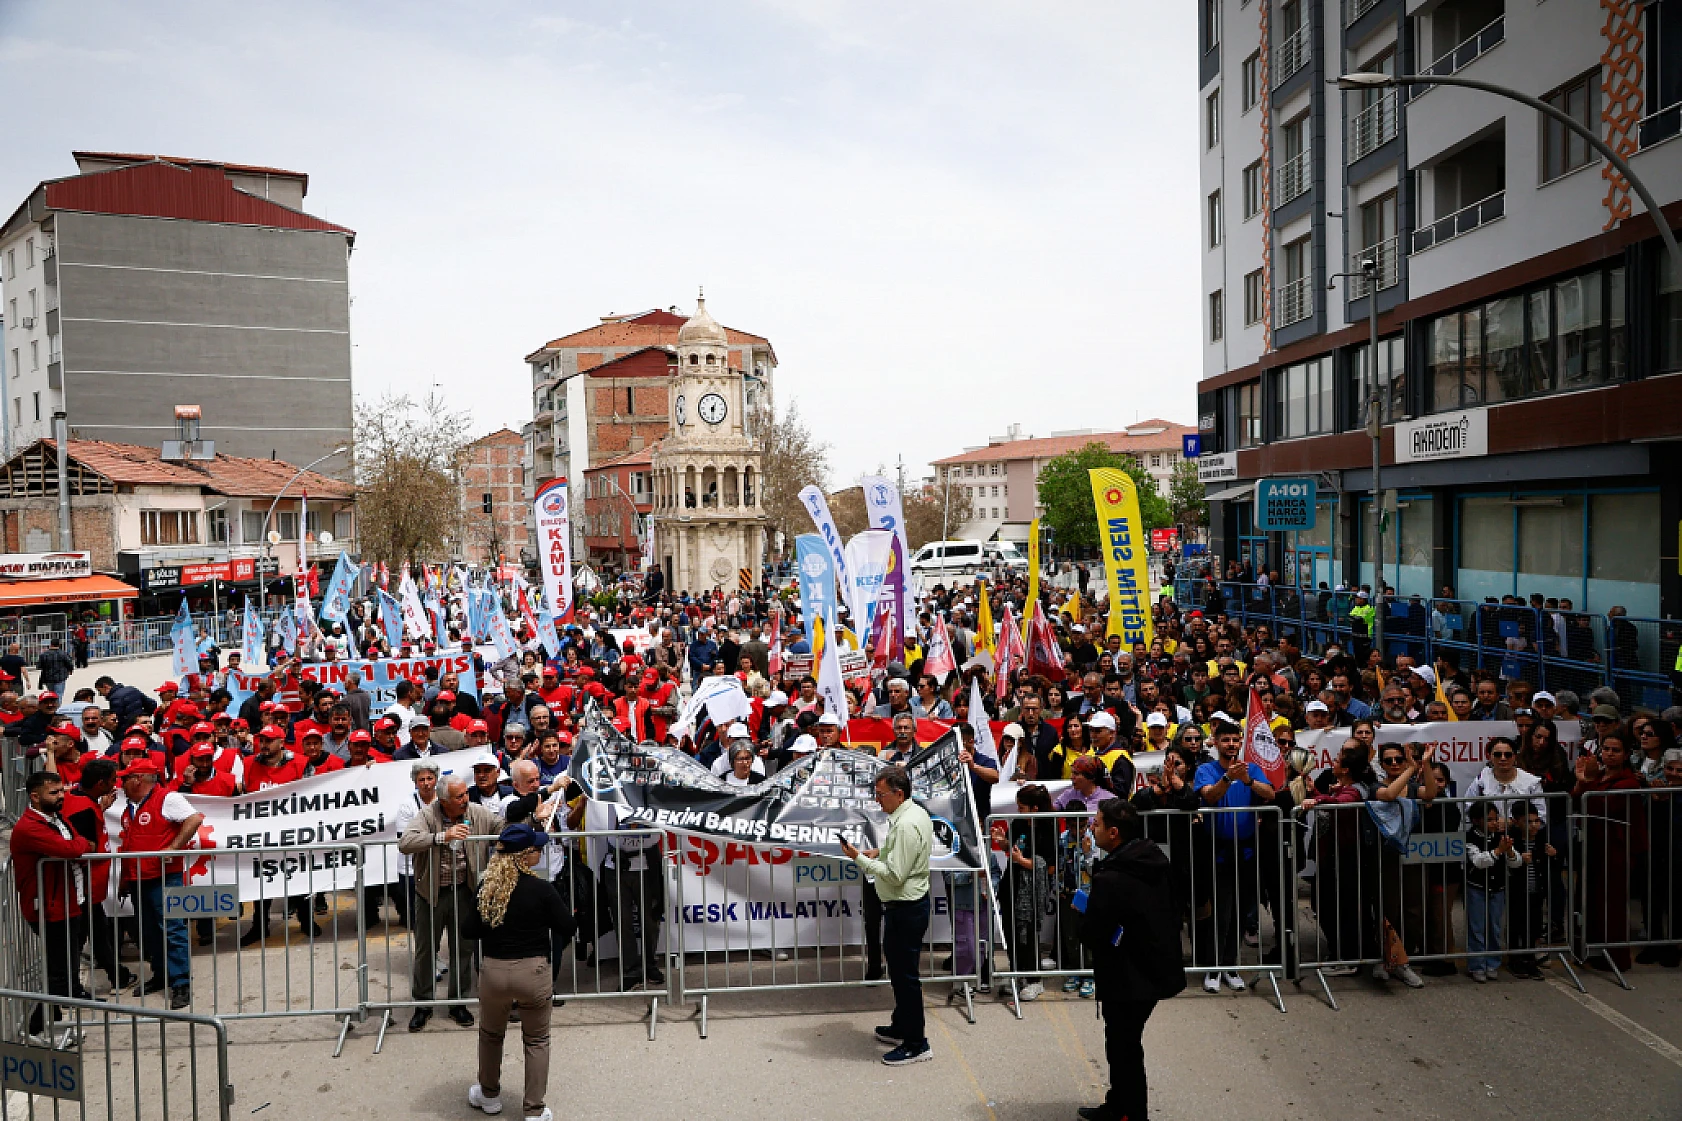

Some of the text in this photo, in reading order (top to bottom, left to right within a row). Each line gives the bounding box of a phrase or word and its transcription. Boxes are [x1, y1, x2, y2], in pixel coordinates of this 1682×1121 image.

[1268, 499, 1307, 507] HARCA
[1268, 507, 1307, 516] HARCA
[548, 528, 565, 576] KAMU
[360, 664, 375, 681] 1
[386, 655, 470, 681] MAYIS
[233, 786, 379, 821] HEKİMHAN
[226, 812, 385, 848] BELEDİYESİ
[656, 806, 704, 826] EKİM
[705, 812, 768, 841] BARIŞ
[770, 823, 862, 844] DERNEĞİ
[1405, 836, 1464, 858] POLİS
[796, 860, 859, 883] POLİS
[166, 890, 235, 913] POLİS
[675, 902, 738, 924] KESK
[745, 899, 852, 921] MALATYA
[3, 1056, 76, 1092] POLİS
